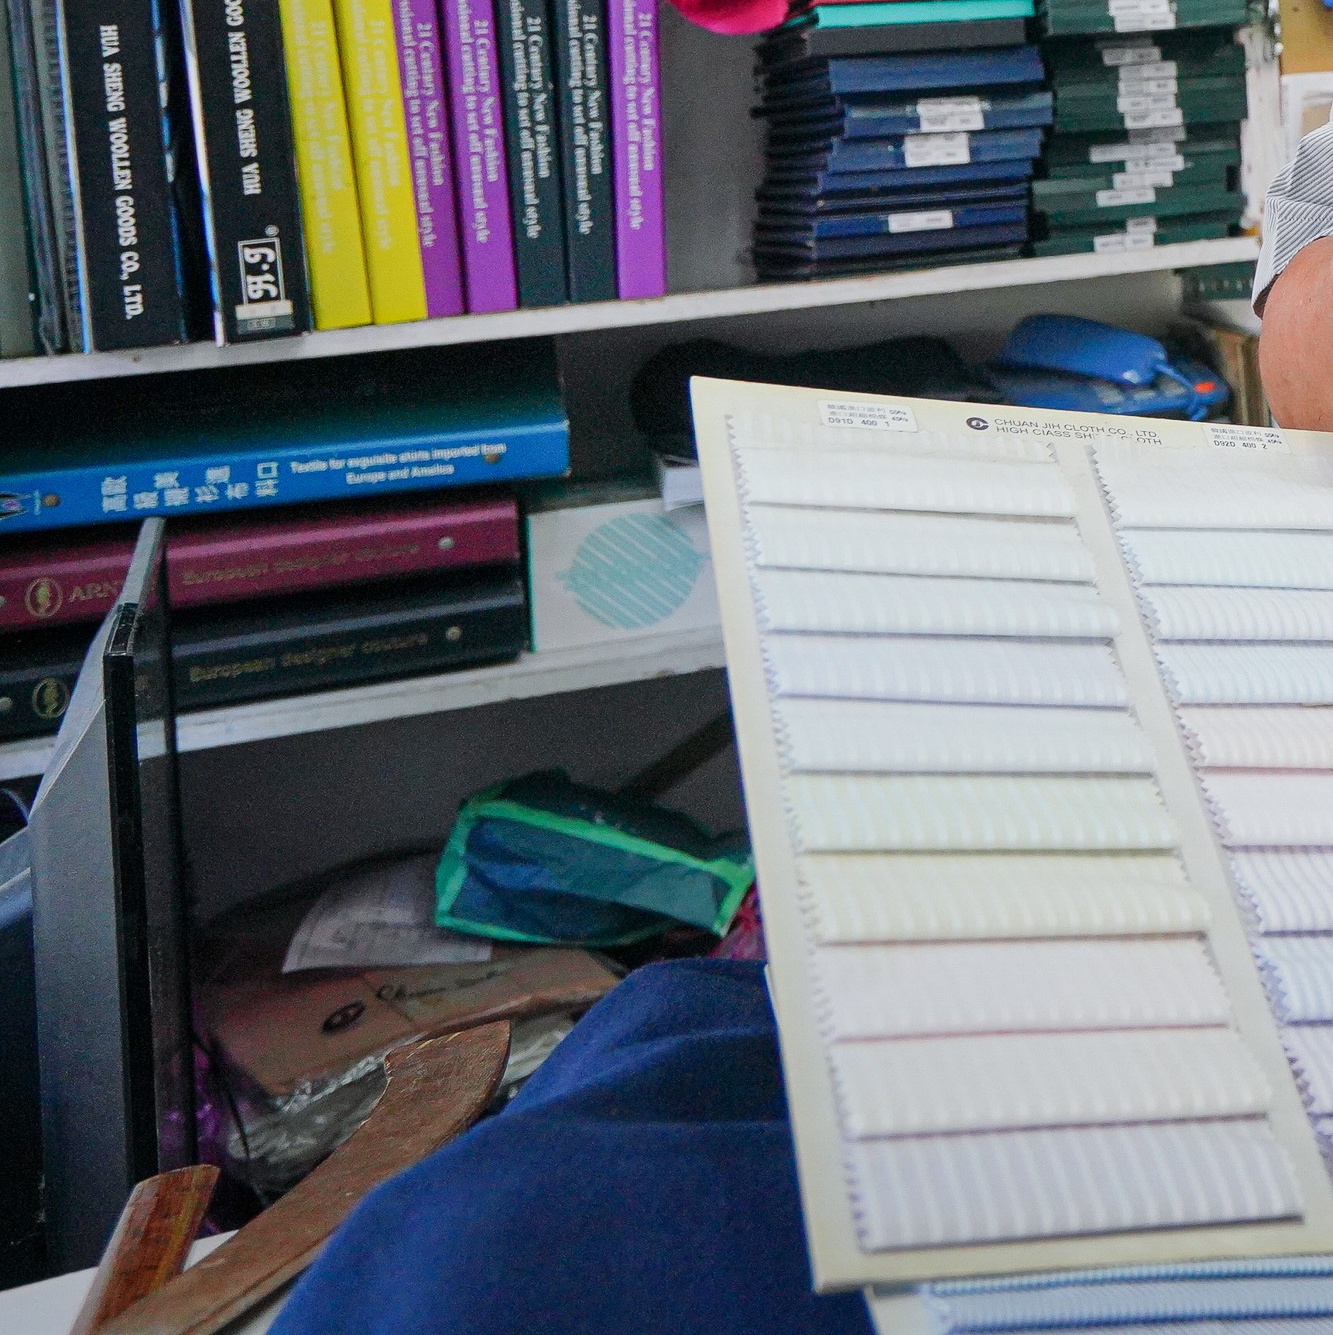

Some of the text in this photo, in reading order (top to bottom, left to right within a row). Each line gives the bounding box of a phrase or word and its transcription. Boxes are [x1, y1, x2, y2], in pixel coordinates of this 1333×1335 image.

[228, 32, 252, 104] WOOLLEN
[512, 41, 530, 91] cutting
[568, 39, 584, 87] cutting
[526, 16, 550, 178] 21 Century New Fashion
[582, 14, 604, 175] 21 Century New Fashion
[235, 108, 258, 158] SHENG
[519, 129, 535, 150] off
[574, 125, 588, 146] off
[100, 24, 144, 320] HUA SHENG WOOLLEN GOODS CO., LTD.
[241, 162, 262, 196] HUA
[523, 206, 541, 239] style
[576, 202, 593, 235] style
[828, 416, 853, 425] D91D
[861, 418, 878, 426] 400
[994, 418, 1038, 429] CHUAN
[1042, 422, 1061, 430] JIH
[1064, 423, 1104, 434] CLOTH
[996, 426, 1029, 435] HIGH
[431, 444, 481, 462] imported
[1214, 439, 1236, 448] D92D
[346, 470, 387, 485] Europe
[387, 468, 410, 482] and
